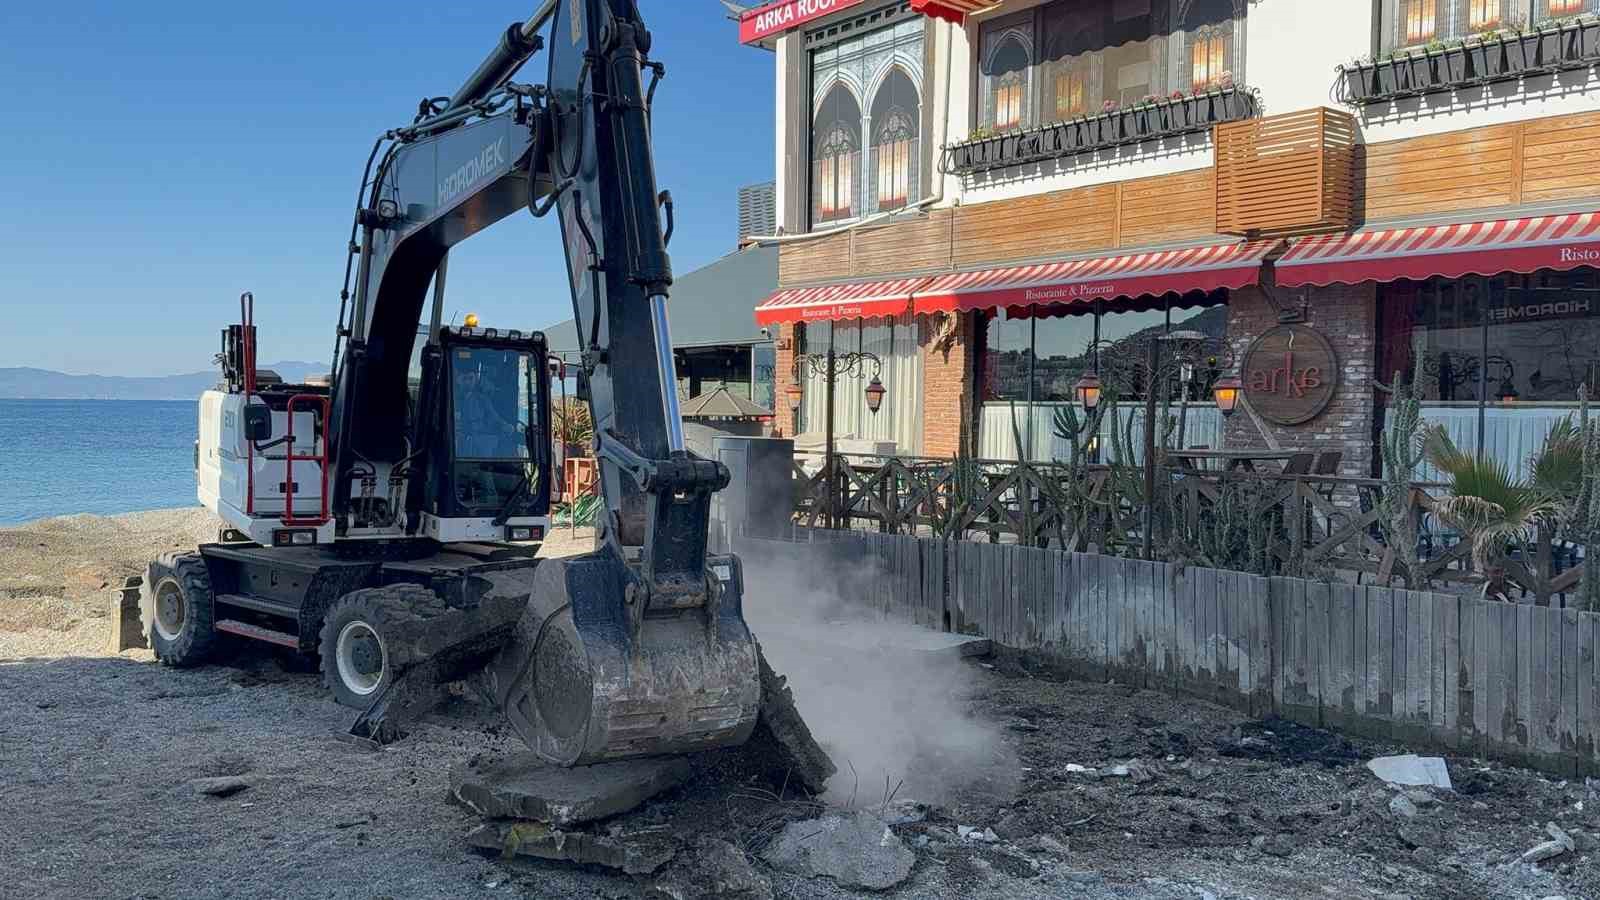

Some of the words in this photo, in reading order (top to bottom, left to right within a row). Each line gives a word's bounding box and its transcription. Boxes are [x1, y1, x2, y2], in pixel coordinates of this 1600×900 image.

[754, 7, 794, 33] ARKA
[797, 0, 837, 18] ROO
[1560, 247, 1600, 262] Risto
[1025, 288, 1068, 300] Ristorante
[1069, 287, 1078, 297] &
[1080, 283, 1115, 296] Pizzeria
